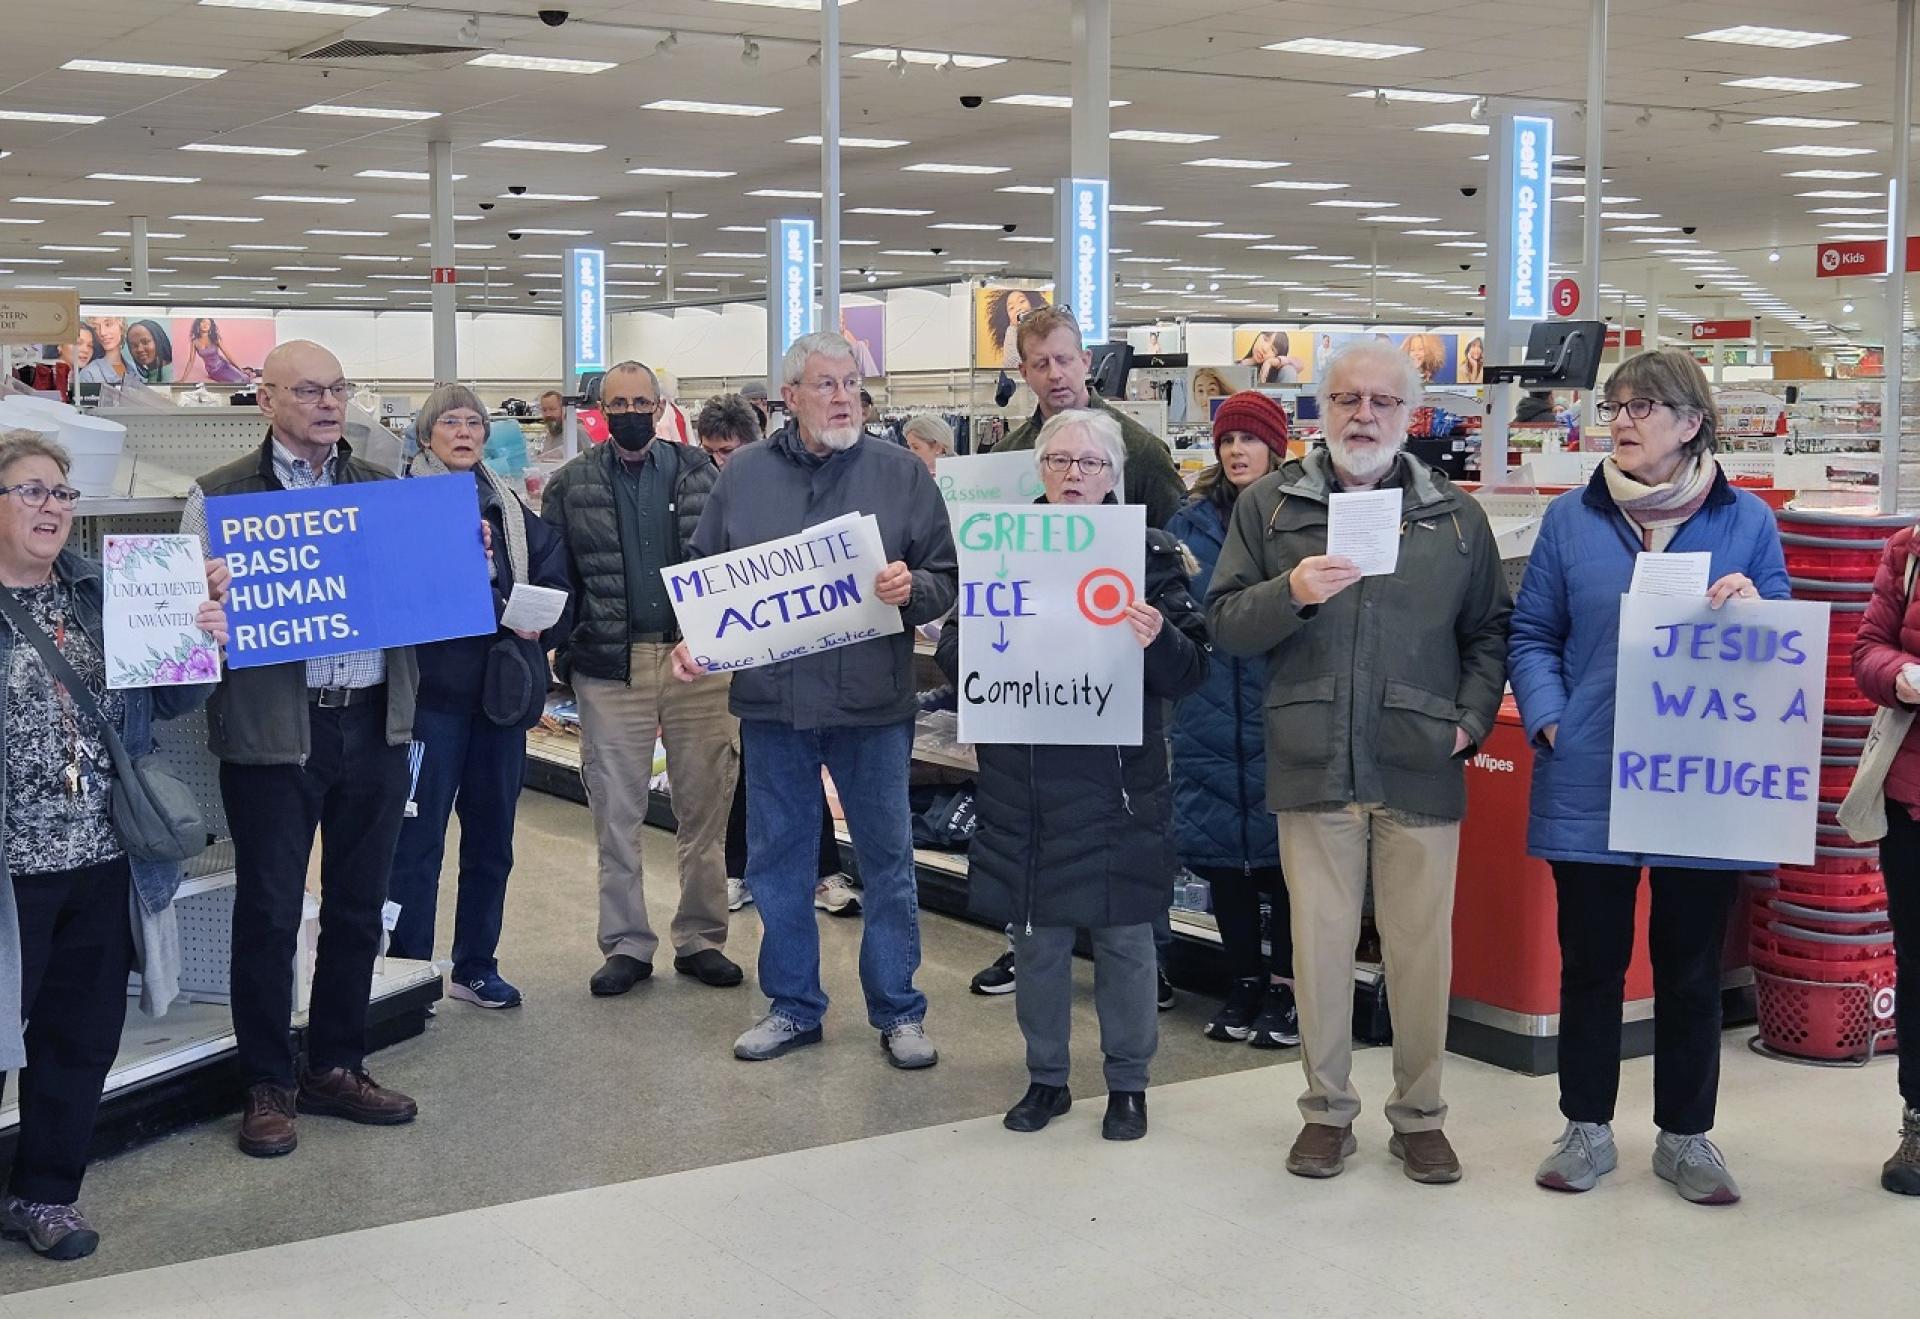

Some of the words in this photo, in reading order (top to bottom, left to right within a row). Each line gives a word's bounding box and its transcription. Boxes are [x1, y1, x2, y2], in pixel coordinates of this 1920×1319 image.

[1520, 130, 1538, 180] self
[1078, 190, 1097, 230] self
[787, 229, 804, 262] self
[1516, 186, 1538, 308] checkout
[1842, 252, 1865, 265] Kids
[580, 257, 595, 287] self
[1078, 235, 1097, 332] checkout
[1560, 288, 1572, 307] 5
[940, 475, 1000, 501] Passive
[222, 507, 360, 545] PROTECT
[959, 512, 1095, 552] GREED
[226, 545, 321, 578] BASIC
[671, 530, 859, 603] MENNONITE
[113, 581, 205, 598] UNDOCUMENTED
[230, 575, 347, 613] HUMAN
[715, 573, 862, 639] ACTION
[961, 580, 1037, 617] ICE
[128, 613, 194, 629] UNWANTED
[236, 613, 360, 651] RIGHTS.
[695, 655, 754, 672] Peace
[768, 647, 808, 661] Love
[817, 628, 881, 649] Justice
[1652, 623, 1807, 665] JESUS
[964, 670, 1113, 717] Complicity
[1652, 681, 1758, 723] WAS
[1780, 688, 1809, 724] A
[1474, 753, 1514, 773] Wipes
[1618, 751, 1811, 801] REFUGEE
